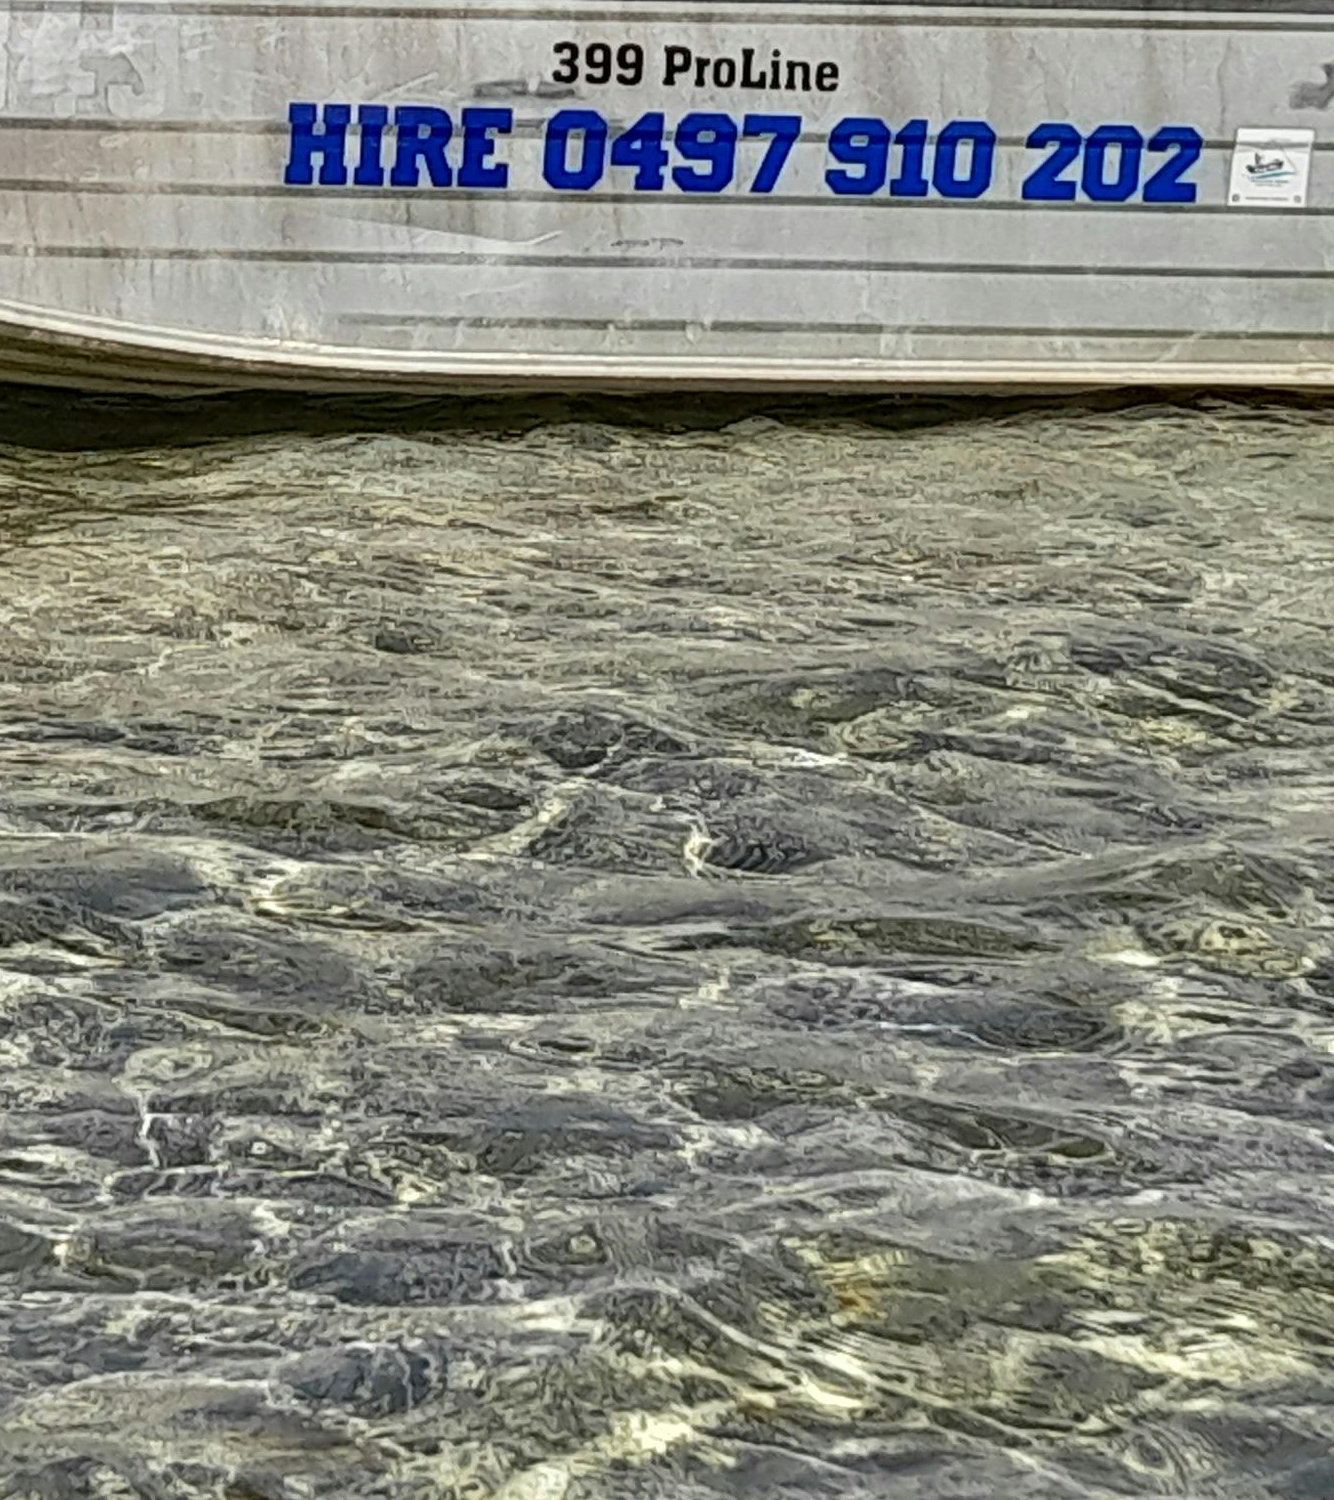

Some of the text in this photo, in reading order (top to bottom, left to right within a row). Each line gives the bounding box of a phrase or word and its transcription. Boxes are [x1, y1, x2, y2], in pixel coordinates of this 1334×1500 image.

[553, 41, 840, 92] 399 ProLine
[284, 102, 1204, 204] HIRE 0497 910 202
